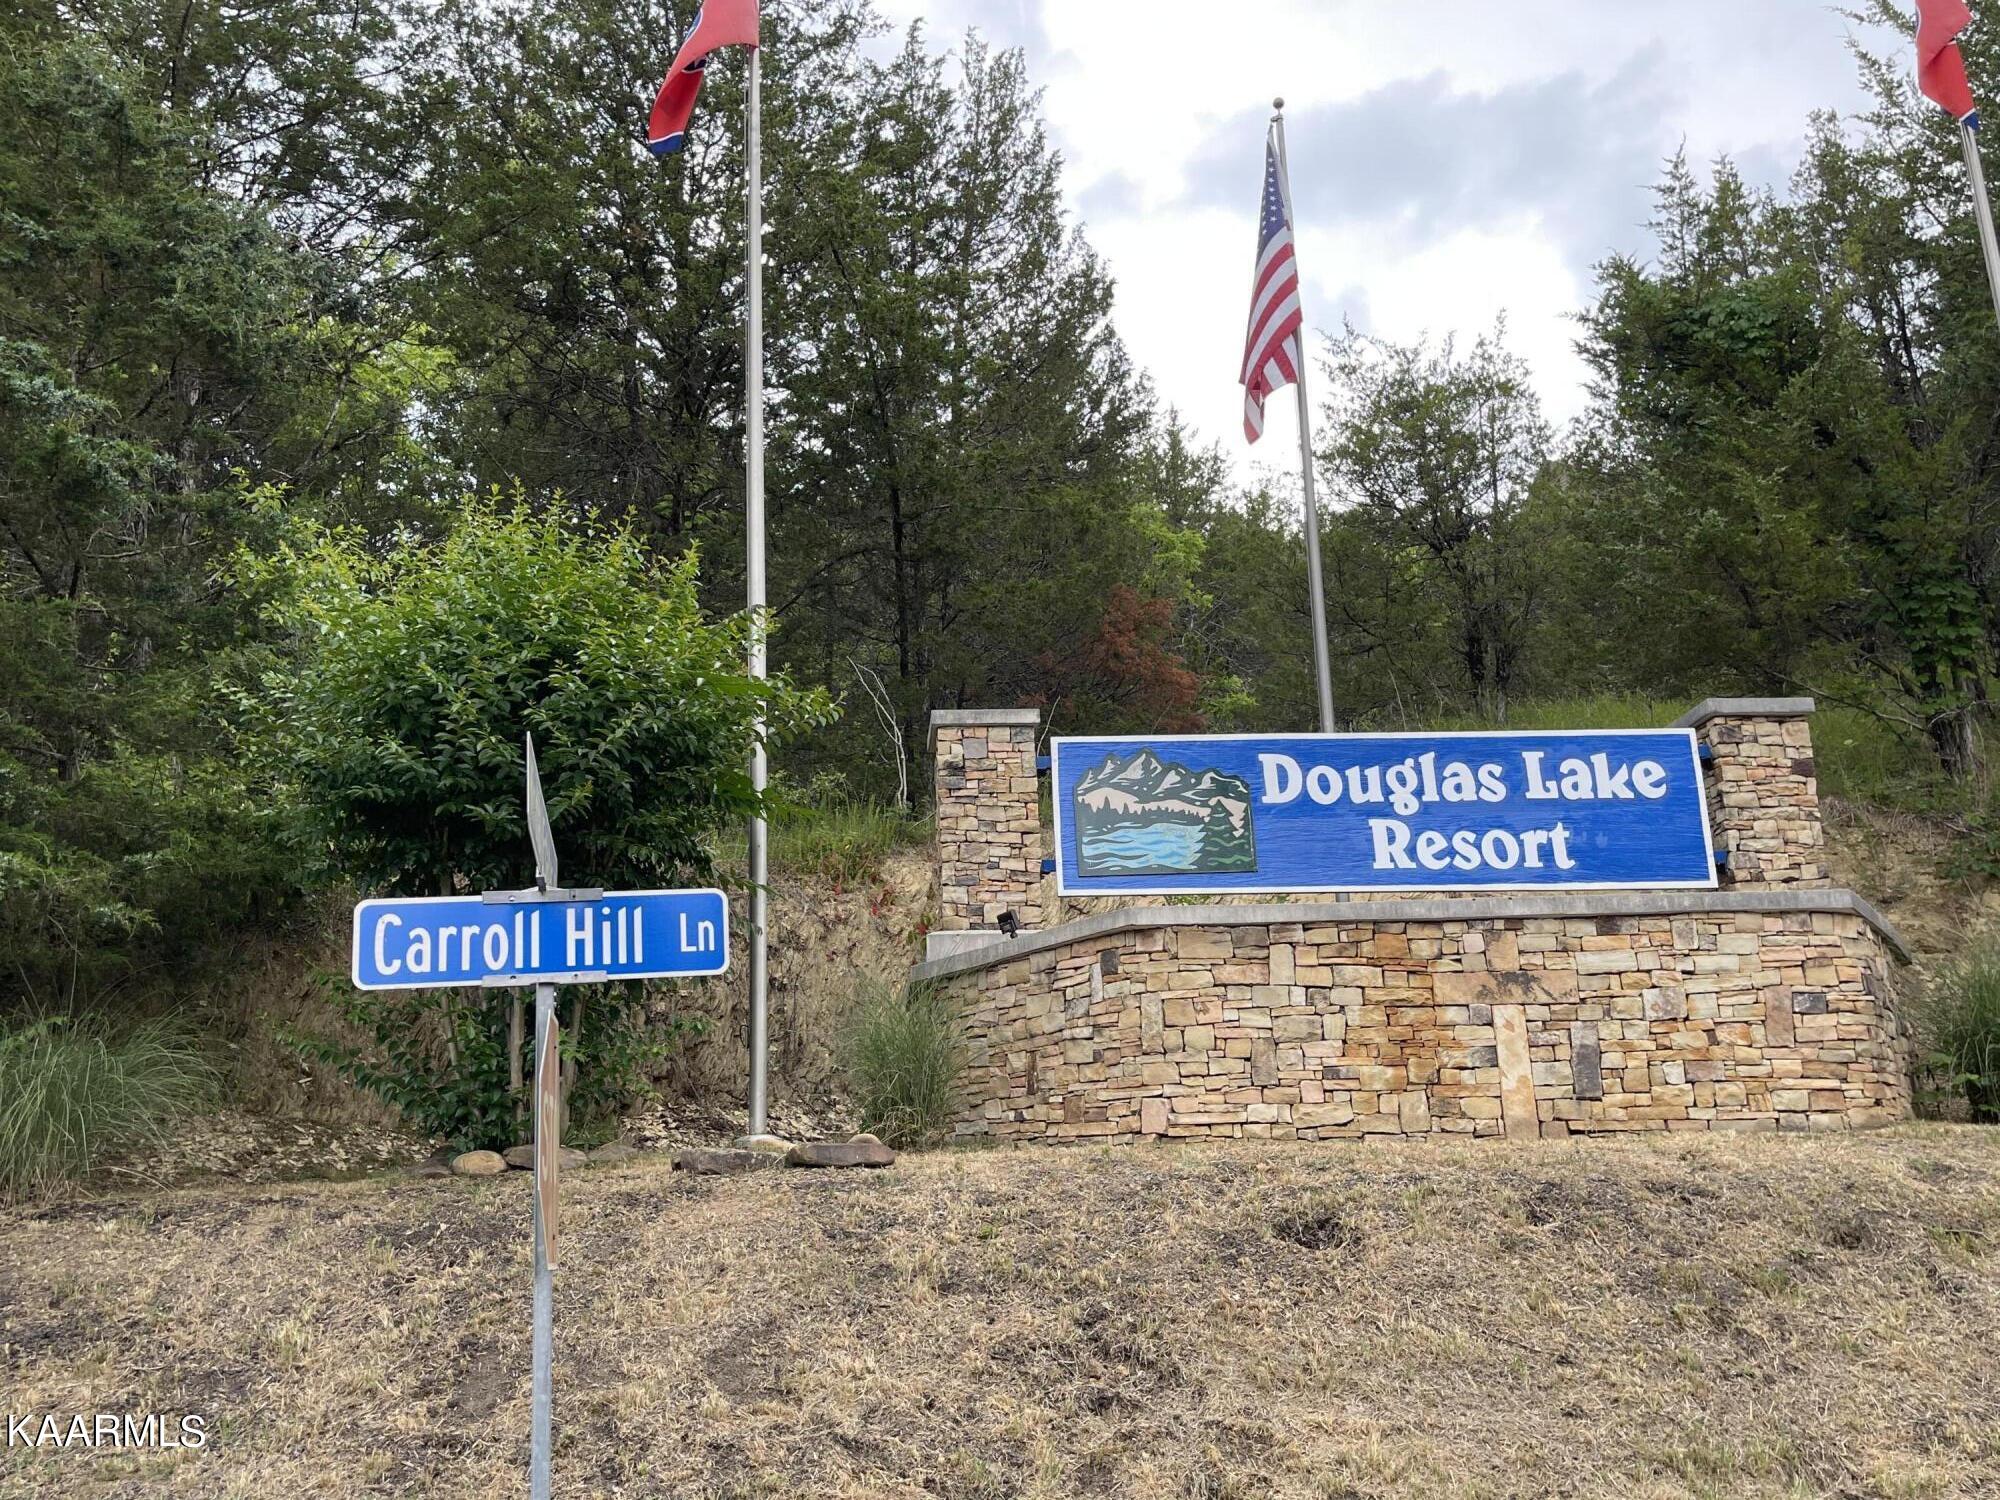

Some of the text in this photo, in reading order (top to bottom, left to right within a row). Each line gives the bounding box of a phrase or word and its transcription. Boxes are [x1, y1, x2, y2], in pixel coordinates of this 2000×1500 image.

[1258, 751, 1667, 816] Douglas Lake
[1369, 818, 1576, 871] Resort
[374, 906, 715, 976] Carroll Hill Ln
